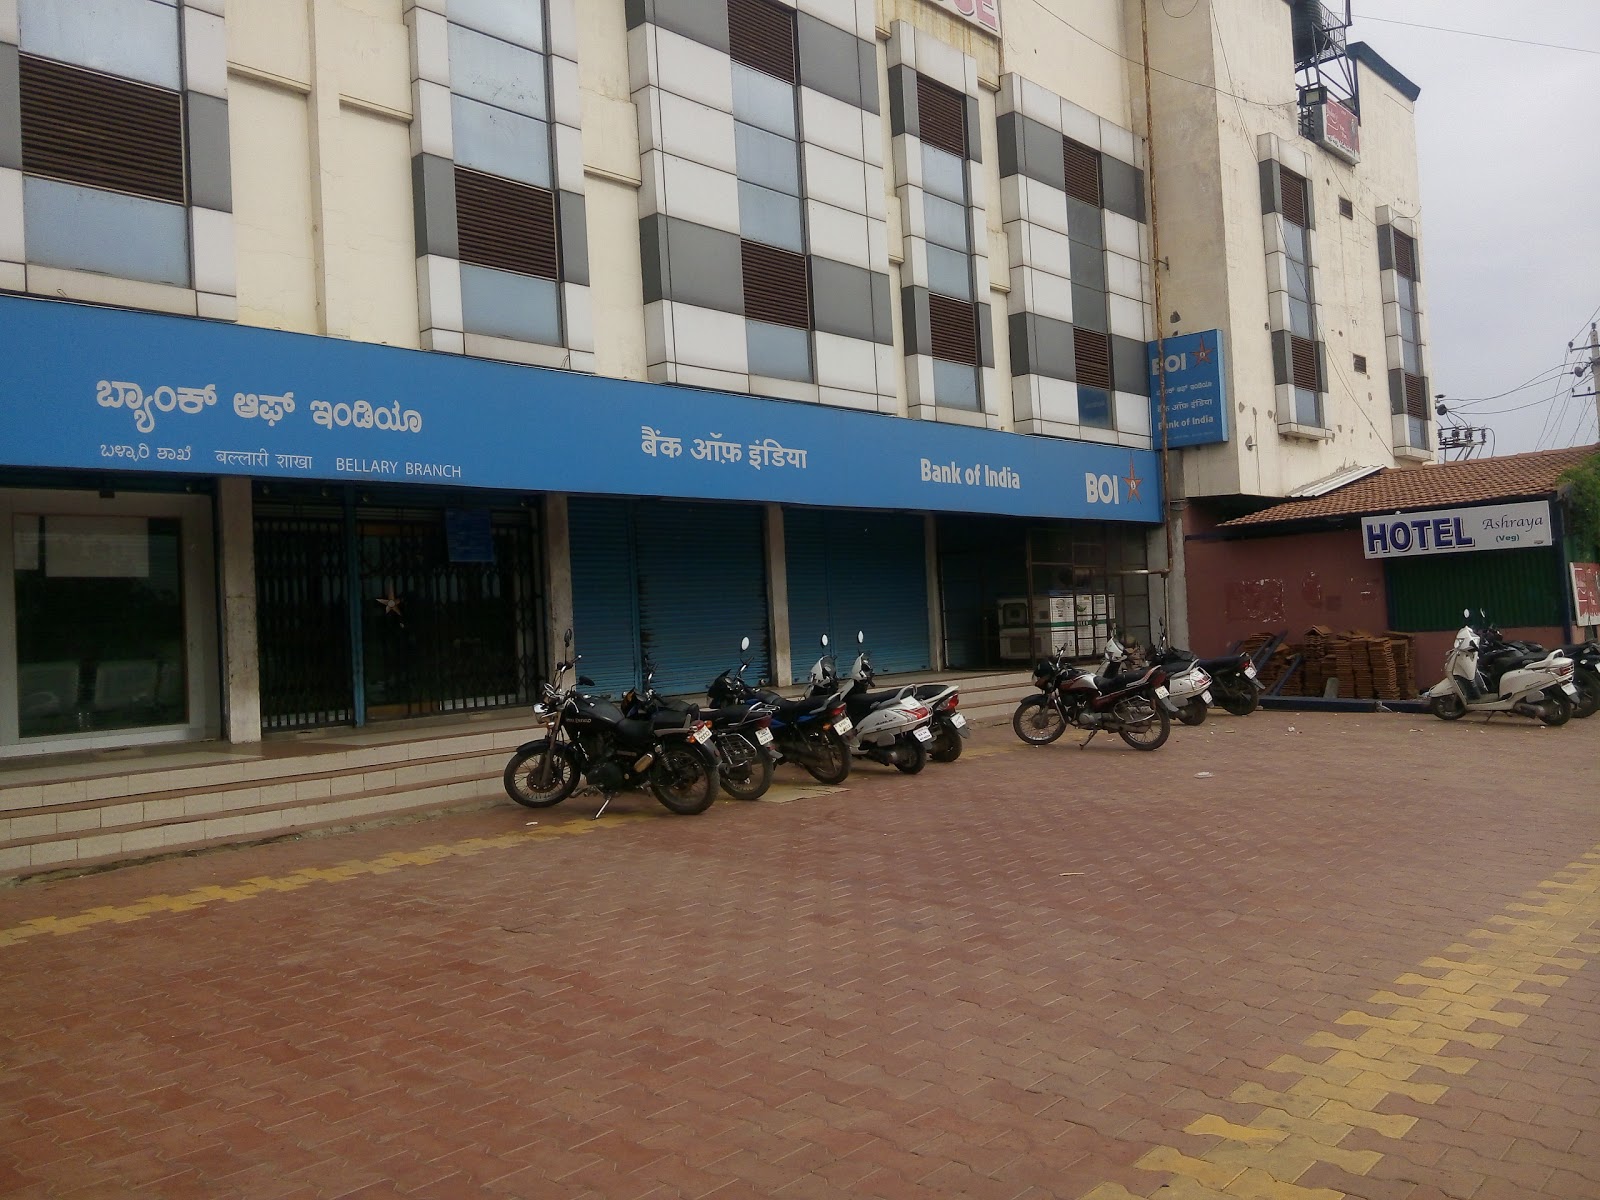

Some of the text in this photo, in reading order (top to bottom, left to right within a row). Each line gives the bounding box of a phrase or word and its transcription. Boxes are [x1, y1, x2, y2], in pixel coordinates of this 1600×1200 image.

[1181, 417, 1190, 427] of
[1193, 414, 1214, 425] India
[214, 448, 313, 470] बल्लारी शाखा
[641, 425, 683, 458] बैंक
[748, 438, 808, 471] इंडिया
[336, 457, 461, 478] BELLARY BRANCH
[920, 458, 1021, 490] Bank of India
[1085, 472, 1120, 505] BOI
[1482, 514, 1544, 533] Ashraya
[1366, 516, 1475, 554] HOTEL
[1495, 533, 1520, 543] (Veg)
